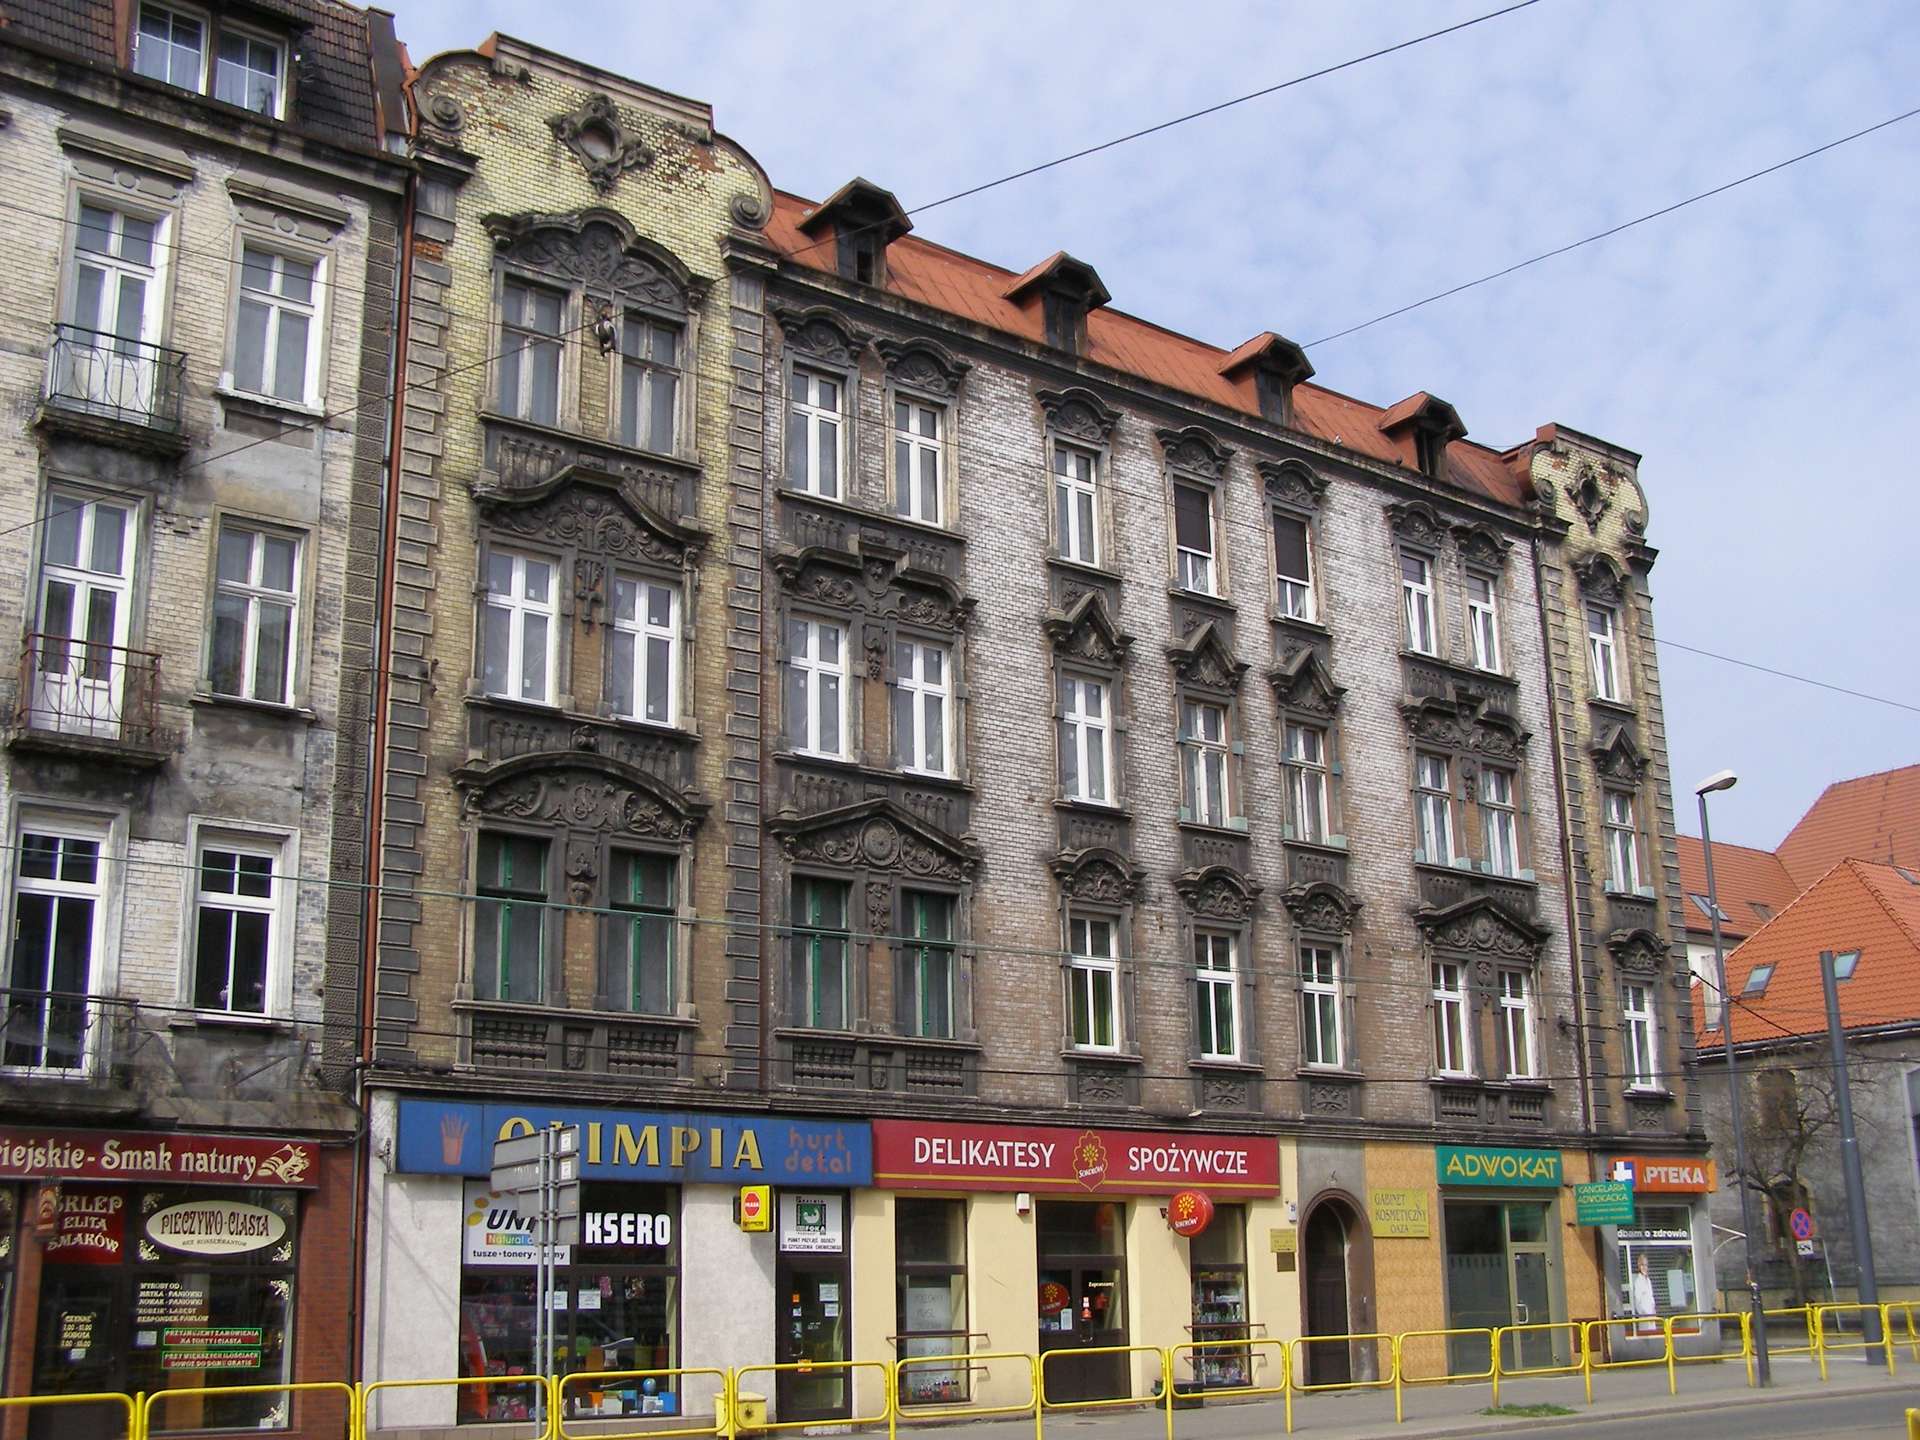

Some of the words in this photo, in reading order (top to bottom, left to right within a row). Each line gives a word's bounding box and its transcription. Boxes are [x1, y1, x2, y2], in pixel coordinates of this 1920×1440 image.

[499, 1117, 764, 1169] OIMPIA
[788, 1126, 846, 1150] hurt
[101, 1139, 172, 1172] Smak
[180, 1147, 256, 1180] natury
[784, 1151, 851, 1173] detal
[914, 1137, 1055, 1168] DELIKATESY
[1128, 1143, 1248, 1174] SPOŻYWCZE
[1446, 1154, 1557, 1179] ADWOKAT
[64, 1216, 107, 1231] ELITA
[585, 1212, 671, 1246] KSERO
[1644, 1230, 1651, 1238] o
[1653, 1228, 1688, 1238] zdrowie
[488, 1234, 526, 1245] Natural
[473, 1250, 498, 1258] tusze
[503, 1250, 533, 1259] tonery
